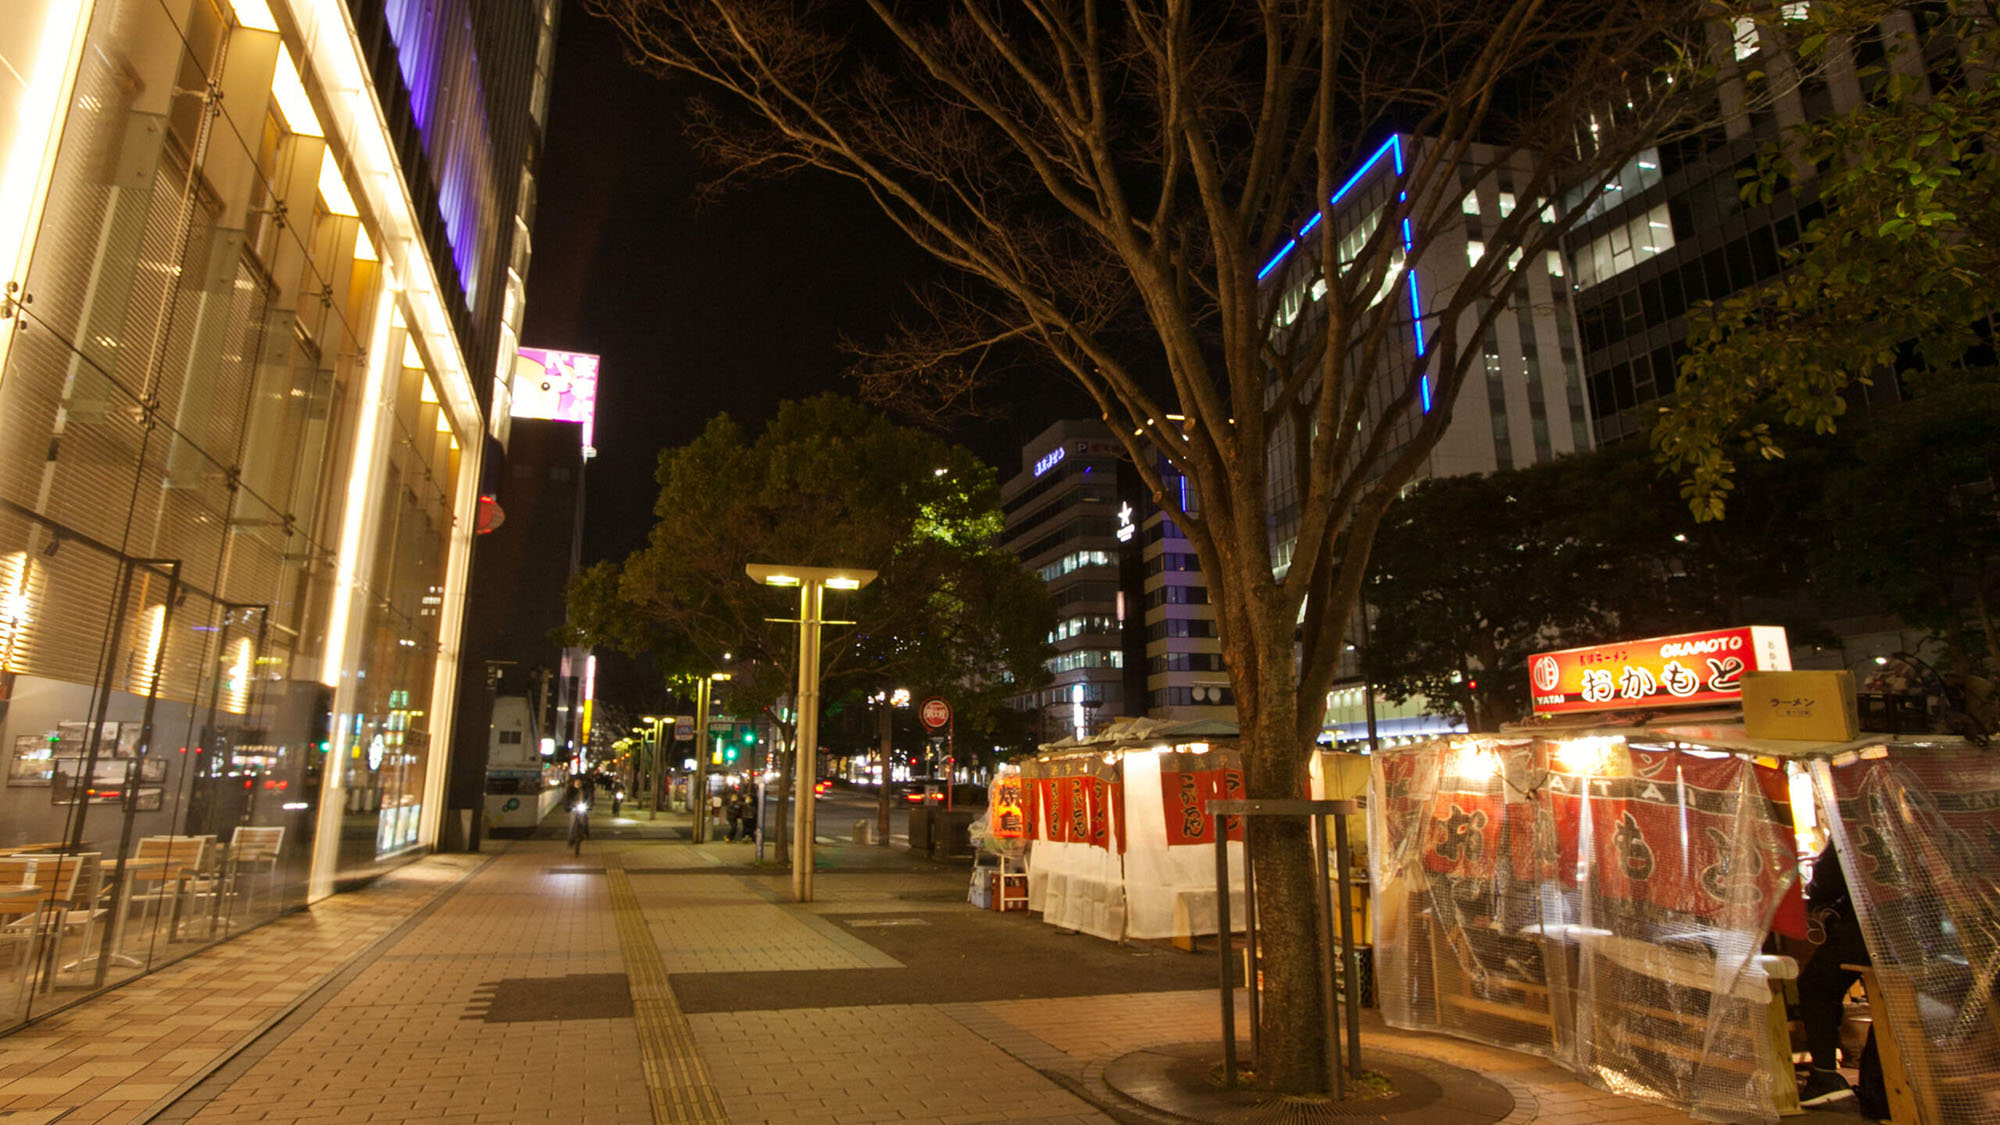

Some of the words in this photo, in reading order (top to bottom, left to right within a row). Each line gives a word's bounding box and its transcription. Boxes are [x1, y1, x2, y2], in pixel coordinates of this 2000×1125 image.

[1660, 636, 1743, 659] OKAMOTO
[1582, 657, 1744, 702] おかもと
[1536, 694, 1565, 706] YATAI
[1770, 697, 1815, 708] ラーメン
